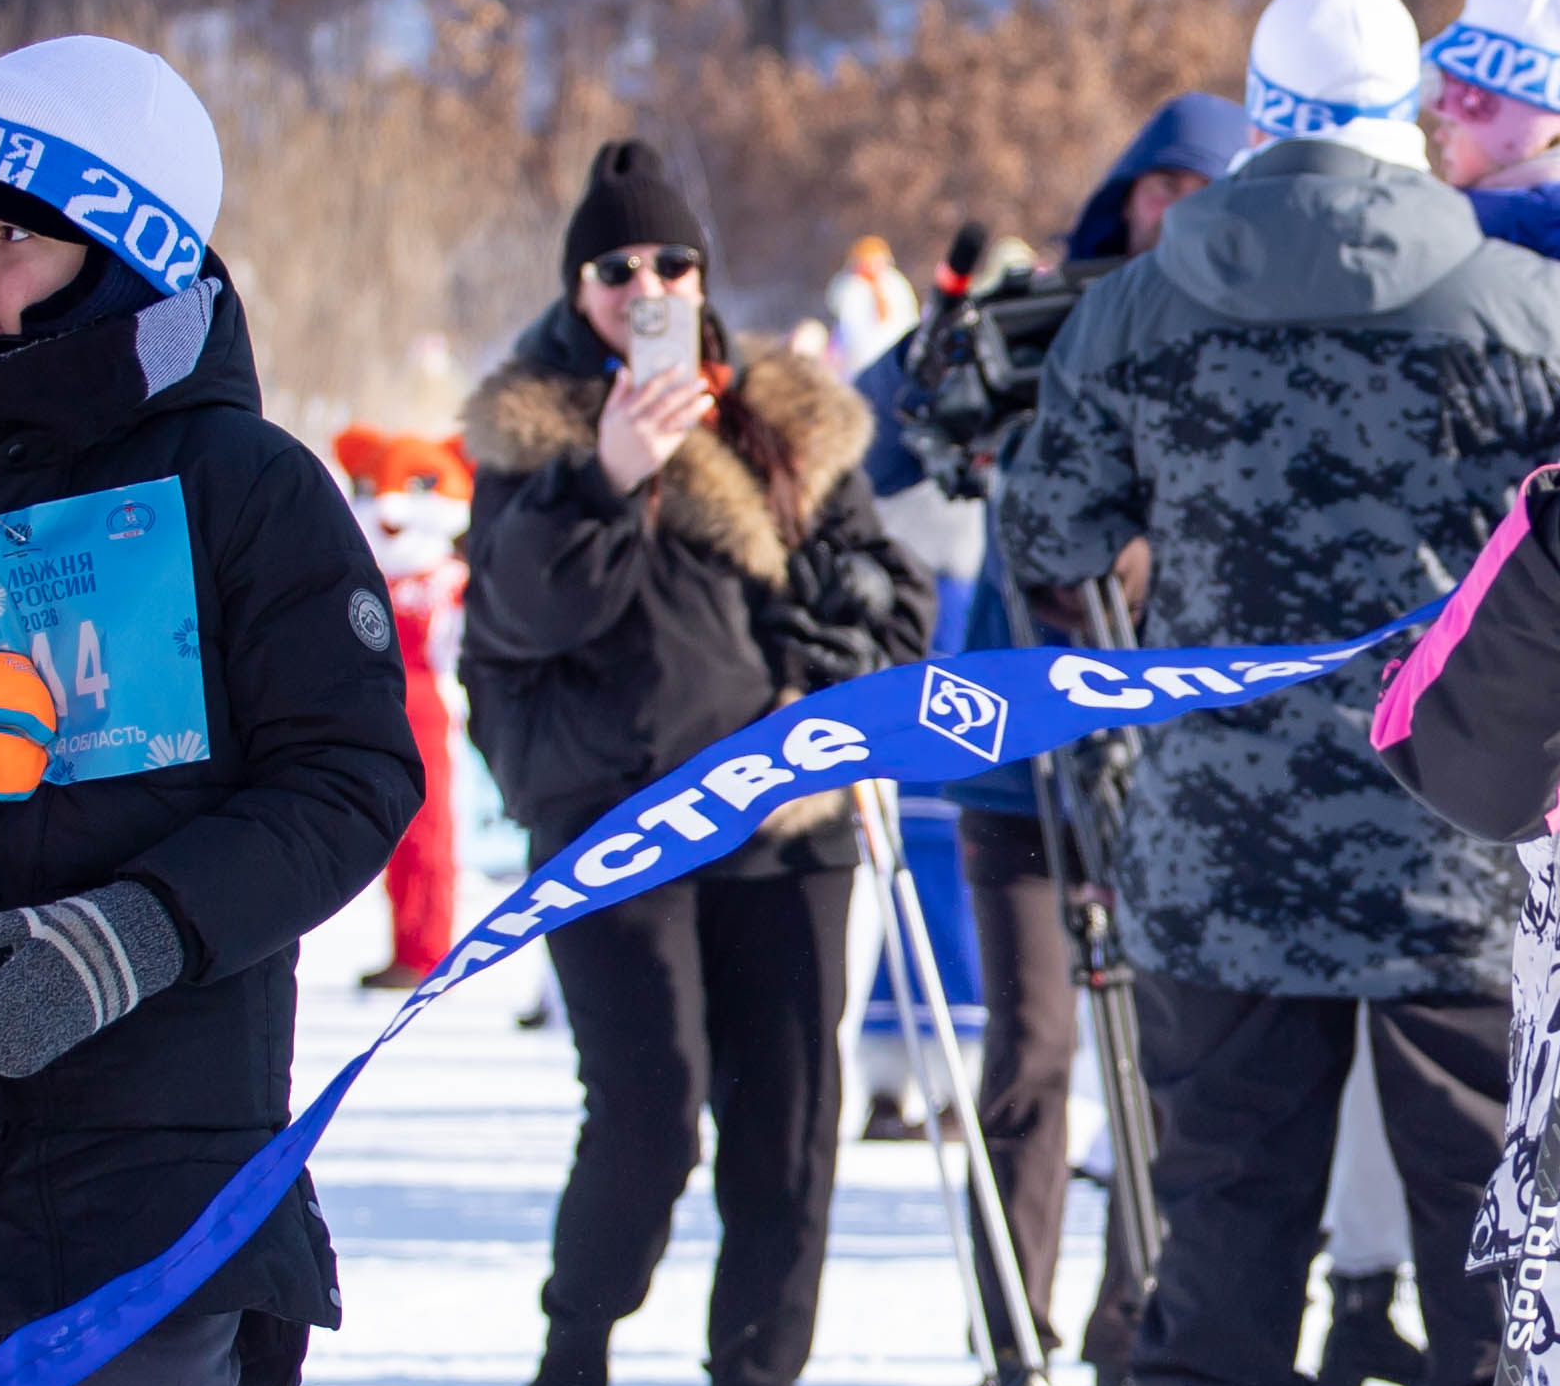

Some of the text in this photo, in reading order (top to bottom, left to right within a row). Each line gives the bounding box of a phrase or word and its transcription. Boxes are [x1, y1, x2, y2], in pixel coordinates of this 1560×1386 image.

[8, 551, 93, 592] ЛЫЖНЯ
[11, 573, 97, 611] РОССИИ
[21, 608, 59, 634] 2026
[70, 726, 147, 755] ОБЛАСТЬ
[1507, 1195, 1559, 1352] SPORT
